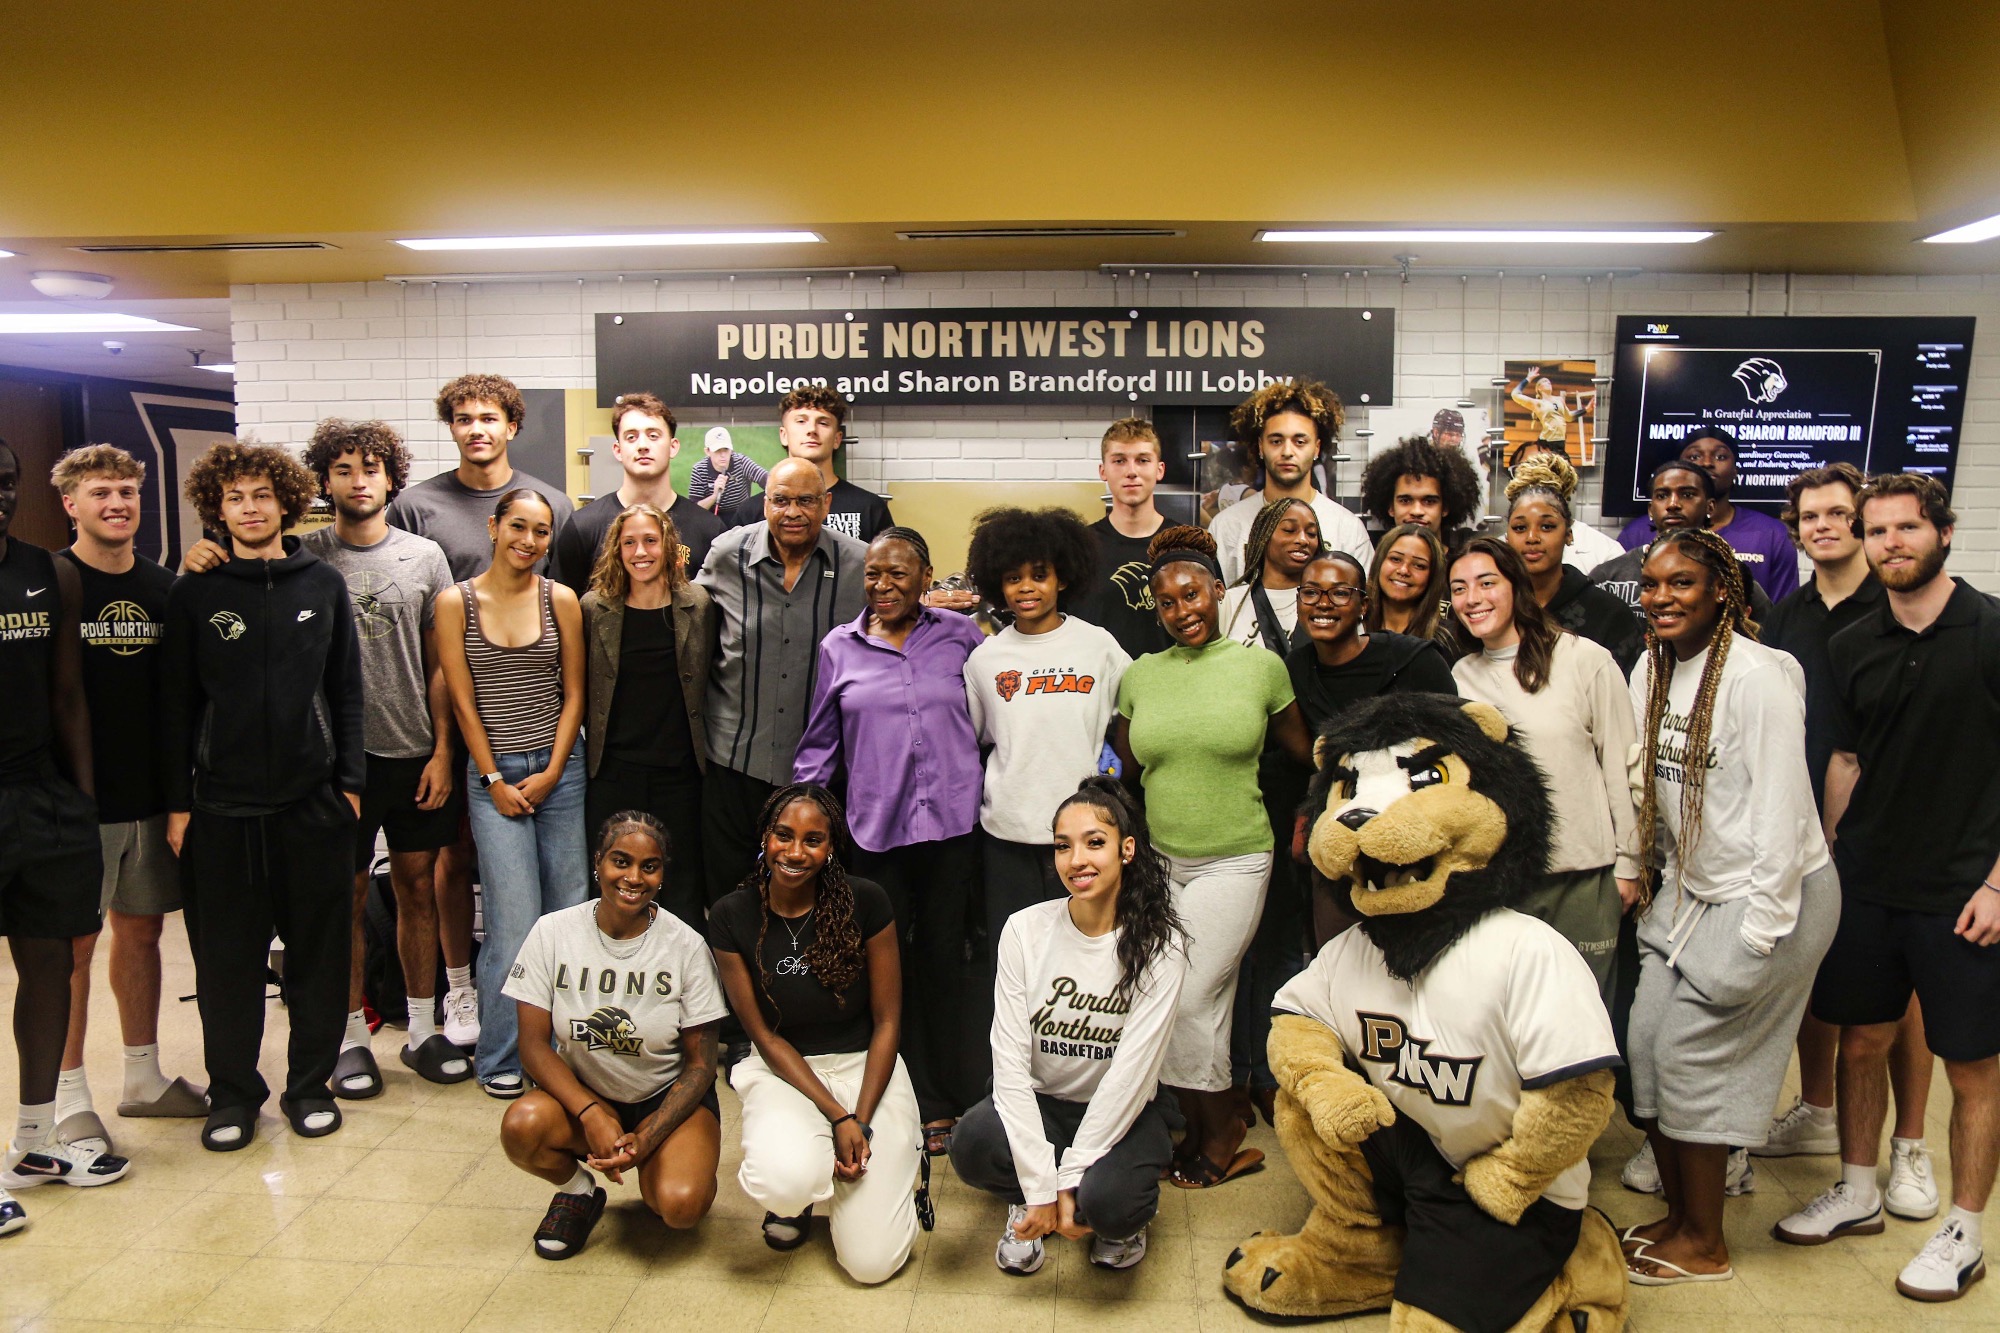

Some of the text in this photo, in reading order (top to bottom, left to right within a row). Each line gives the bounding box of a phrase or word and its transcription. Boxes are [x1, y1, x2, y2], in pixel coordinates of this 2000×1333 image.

[717, 319, 1265, 361] PURDUE NORTHWEST LIONS
[691, 372, 828, 400] Napoleon
[836, 370, 890, 394] and
[898, 370, 1000, 393] Sharon
[1009, 368, 1157, 393] Brandford
[1166, 370, 1192, 392] III
[1702, 408, 1812, 421] In Grateful Appreciation
[1738, 424, 1785, 441] SHARON
[1787, 425, 1848, 441] BRANDFORD
[1849, 425, 1861, 441] III
[1758, 460, 1790, 470] Enduring
[1790, 460, 1817, 470] Support
[1745, 473, 1800, 486] NORTHWE
[826, 512, 861, 524] FAITH
[80, 622, 111, 638] RDUE
[1032, 666, 1075, 675] GIRLS
[1025, 674, 1095, 695] FLAG
[555, 963, 672, 996] LIONS
[1045, 976, 1130, 1015] Purdu
[1029, 1006, 1124, 1043] Northwe
[570, 1019, 643, 1056] PNW
[1040, 1038, 1118, 1061] BASKETBA
[1360, 1013, 1480, 1103] PNW
